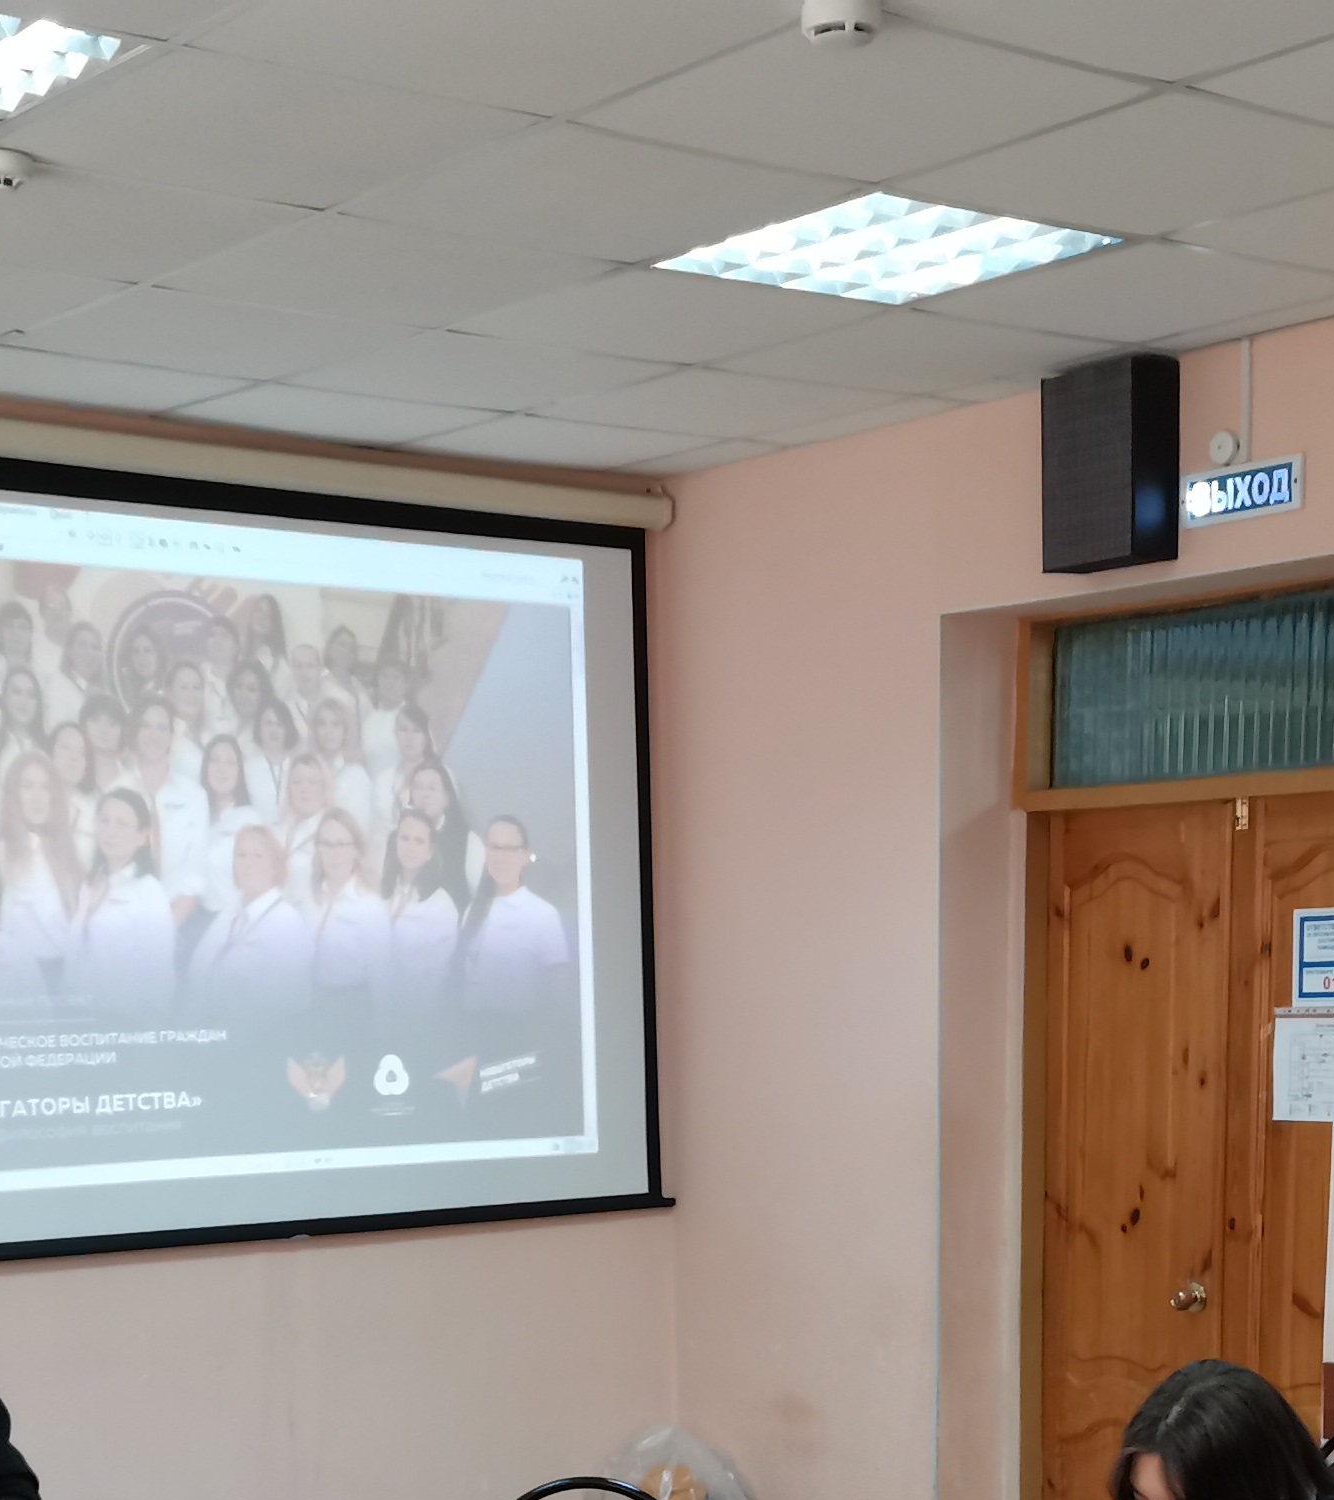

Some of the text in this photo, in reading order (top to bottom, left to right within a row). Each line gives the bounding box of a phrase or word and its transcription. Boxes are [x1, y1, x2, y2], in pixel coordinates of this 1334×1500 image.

[59, 1030, 157, 1048] ВОСПИТАНИЕ
[159, 1029, 227, 1043] ГРАЖДАН
[25, 1051, 117, 1067] ФЕДЕРАЦИИ
[95, 1090, 202, 1115] ДЕТСТВА»
